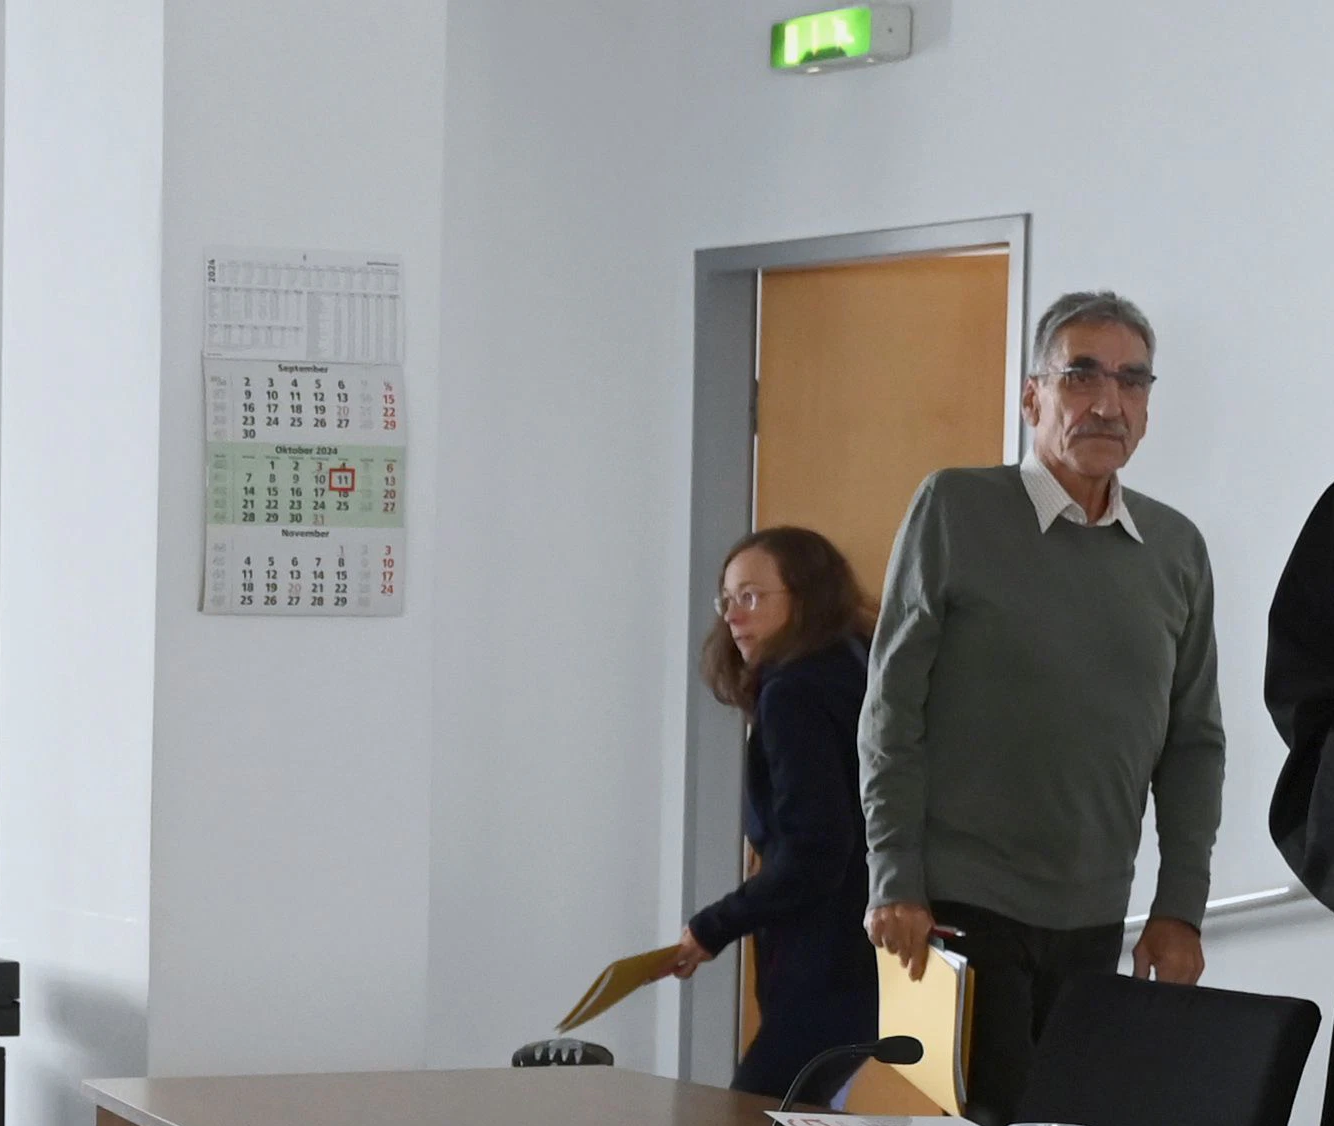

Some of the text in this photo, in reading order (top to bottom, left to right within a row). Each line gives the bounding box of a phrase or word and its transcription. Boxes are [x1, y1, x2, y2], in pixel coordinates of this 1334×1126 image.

[208, 259, 217, 283] 2024
[278, 364, 329, 374] September
[243, 377, 345, 390] 2 3 4 5 6
[244, 390, 395, 405] 9 10 11 12 13 15
[242, 403, 255, 413] 16
[266, 404, 279, 413] 17
[290, 404, 302, 414] 18
[314, 405, 326, 415] 19
[382, 407, 396, 418] 22
[242, 416, 397, 431] 23 24 25 26 27 29
[242, 429, 256, 439] 30
[275, 445, 313, 455] Oktober
[269, 460, 275, 470] 1
[292, 461, 299, 471] 2
[386, 463, 393, 473] 6
[245, 473, 396, 486] 7 8 9 10 11 13
[243, 487, 255, 496] 14
[266, 487, 278, 497] 15
[290, 487, 302, 497] 16
[313, 487, 325, 498] 17
[383, 489, 396, 499] 20
[242, 499, 396, 513] 21 22 23 24 25 27
[242, 512, 256, 523] 28
[265, 513, 279, 523] 29
[289, 513, 303, 523] 30
[281, 529, 330, 538] November
[385, 545, 392, 555] 3
[244, 557, 252, 567] 4
[268, 557, 275, 567] 5
[291, 557, 299, 567] 6
[315, 558, 322, 567] 7
[337, 558, 345, 568] 8
[382, 558, 395, 569] 10
[241, 569, 394, 582] 11 12 13 14 15 17
[242, 582, 254, 592] 18
[265, 583, 278, 593] 19
[311, 583, 324, 593] 21
[334, 583, 348, 593] 22
[380, 584, 394, 594] 24
[240, 595, 347, 606] 25 26 27 28 29
